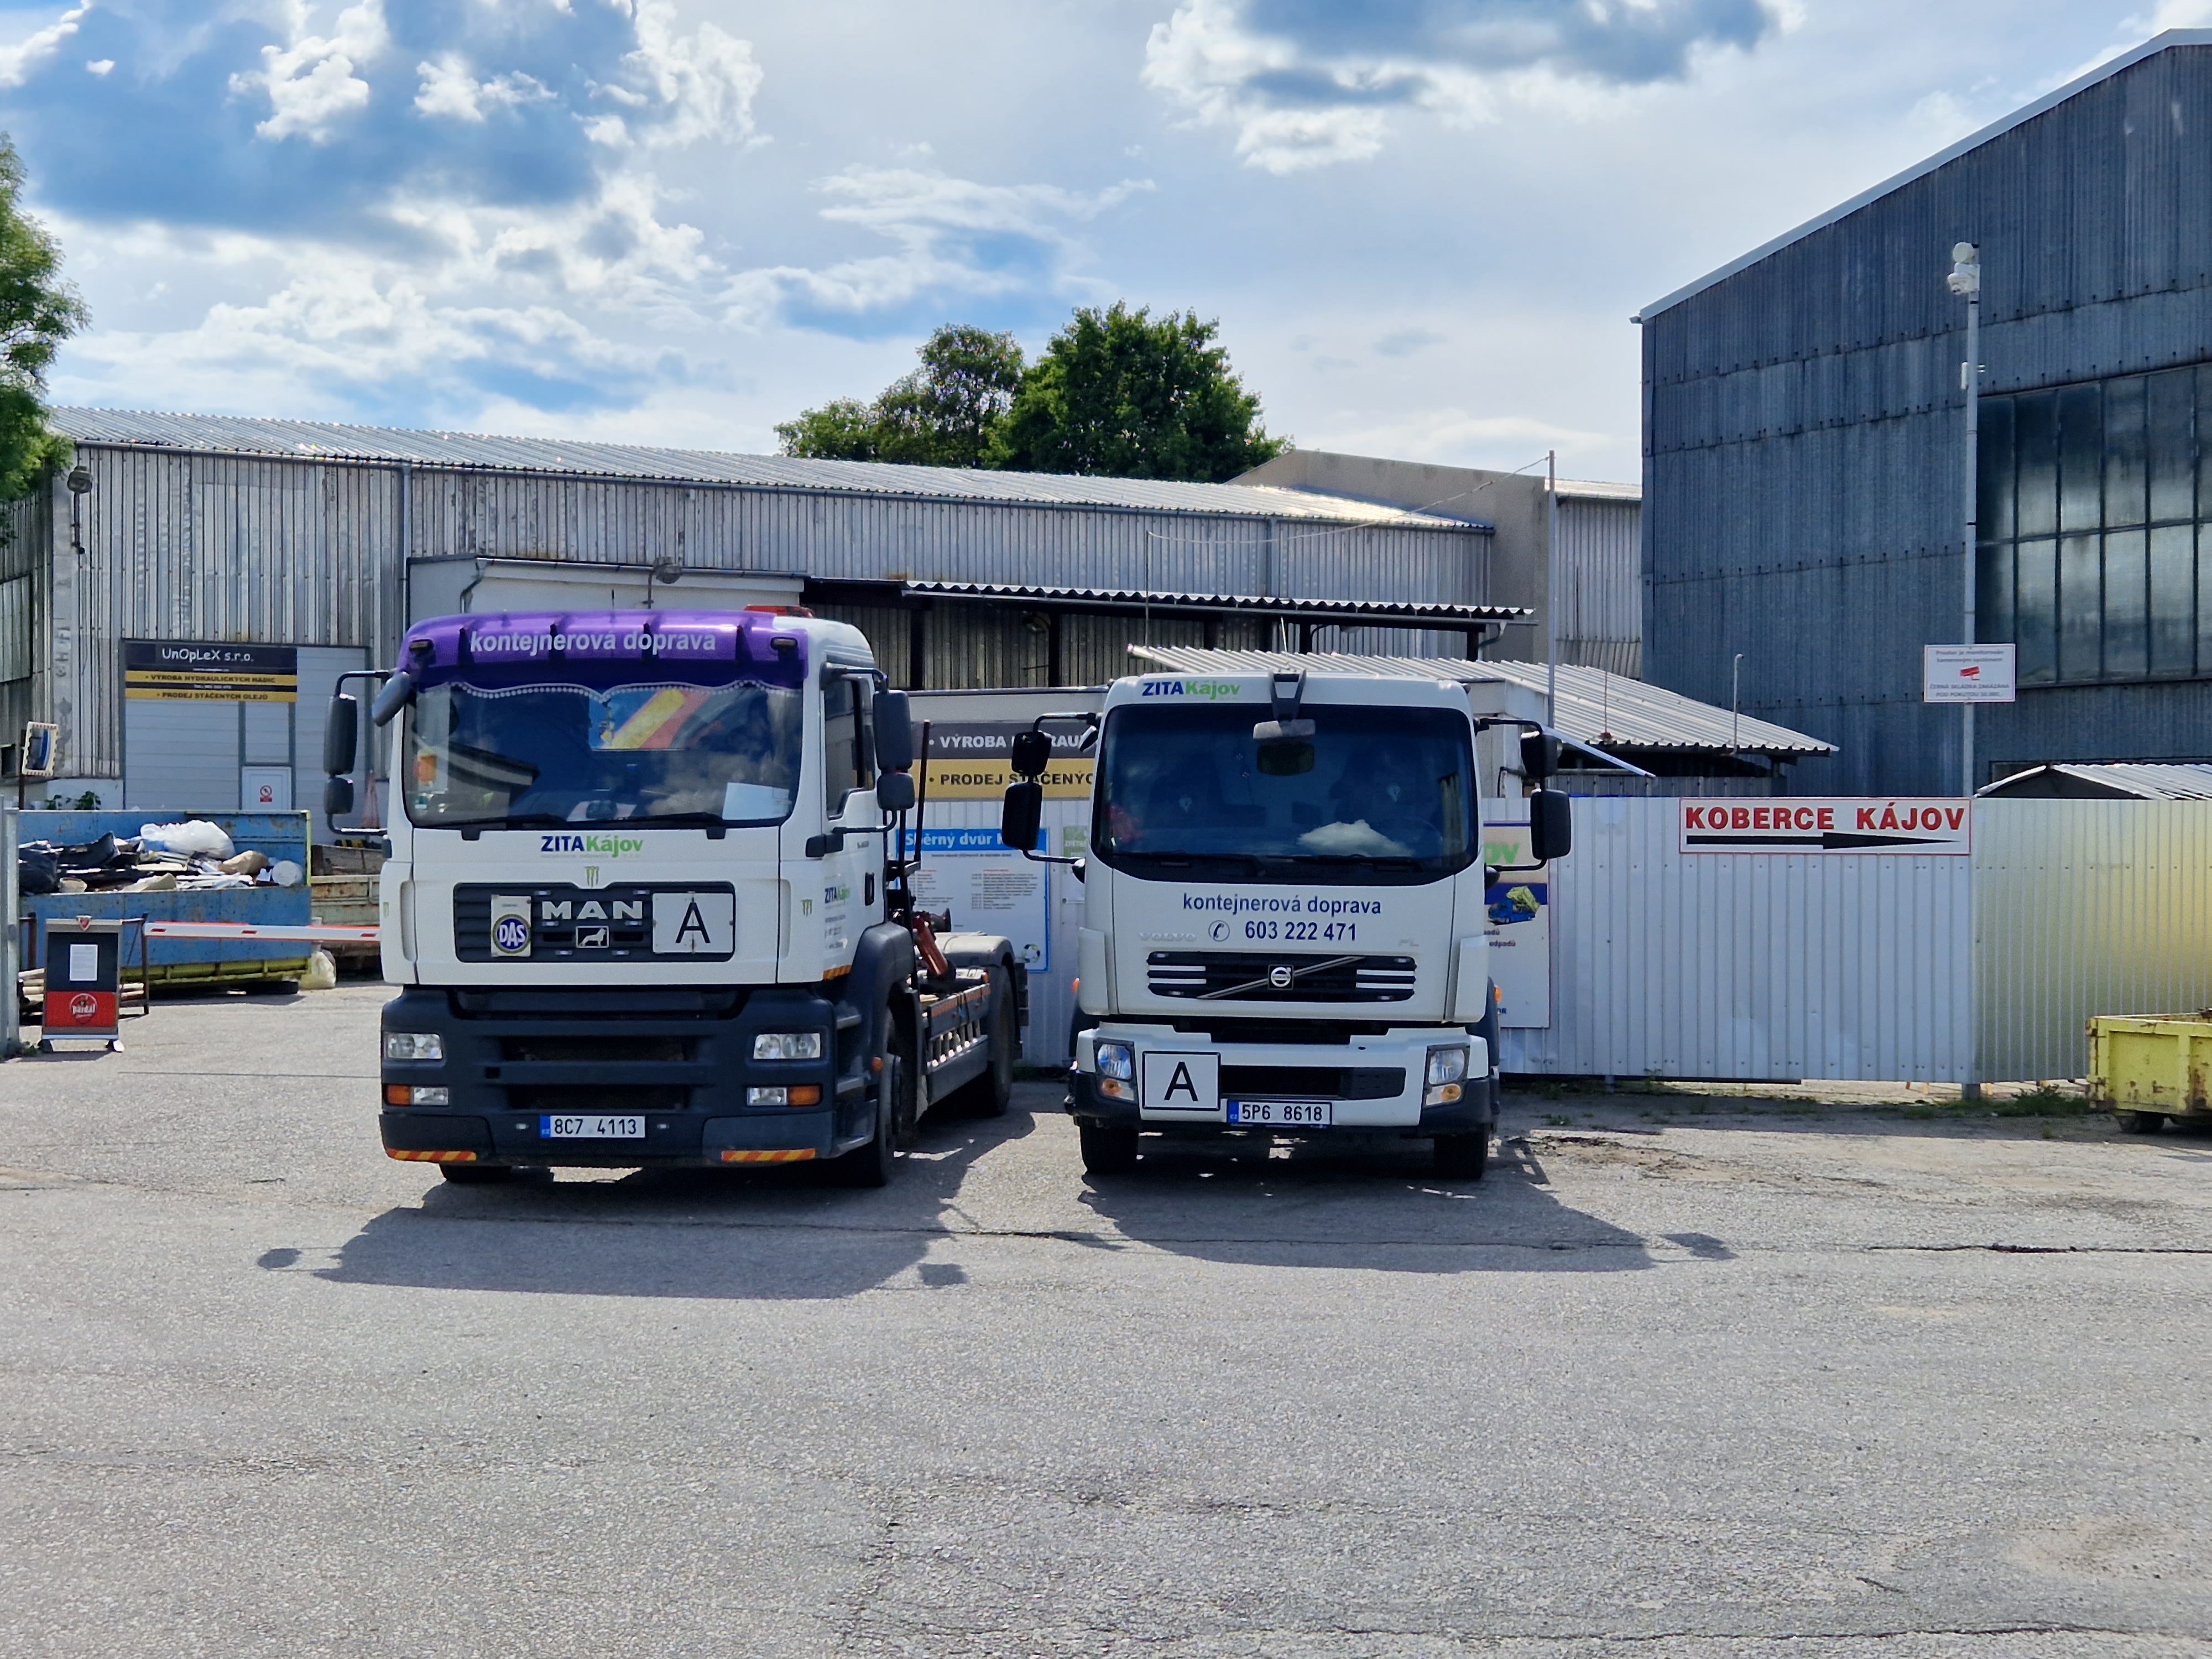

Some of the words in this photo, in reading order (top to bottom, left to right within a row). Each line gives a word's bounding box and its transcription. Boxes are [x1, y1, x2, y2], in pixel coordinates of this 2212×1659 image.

[470, 630, 616, 656] kontejnerová
[623, 629, 716, 655] doprava
[224, 651, 254, 662] s.r.o.
[940, 733, 1006, 748] VÝROBA
[941, 774, 1003, 785] PRODEJ
[1686, 807, 1834, 830] KOBERCE
[1856, 801, 1965, 830] KÁJOV
[542, 900, 643, 920] MAN
[1183, 893, 1301, 915] kontejnerová
[1307, 896, 1381, 917] doprava
[675, 902, 711, 943] A
[1245, 921, 1278, 940] 603
[1285, 922, 1318, 941] 222
[1323, 923, 1357, 941] 471
[499, 922, 525, 946] DAS
[1164, 1062, 1198, 1102] A
[1242, 1104, 1271, 1120] 5P6
[1284, 1105, 1322, 1121] 8618
[555, 1119, 583, 1135] 8C7
[597, 1119, 637, 1135] 4113
